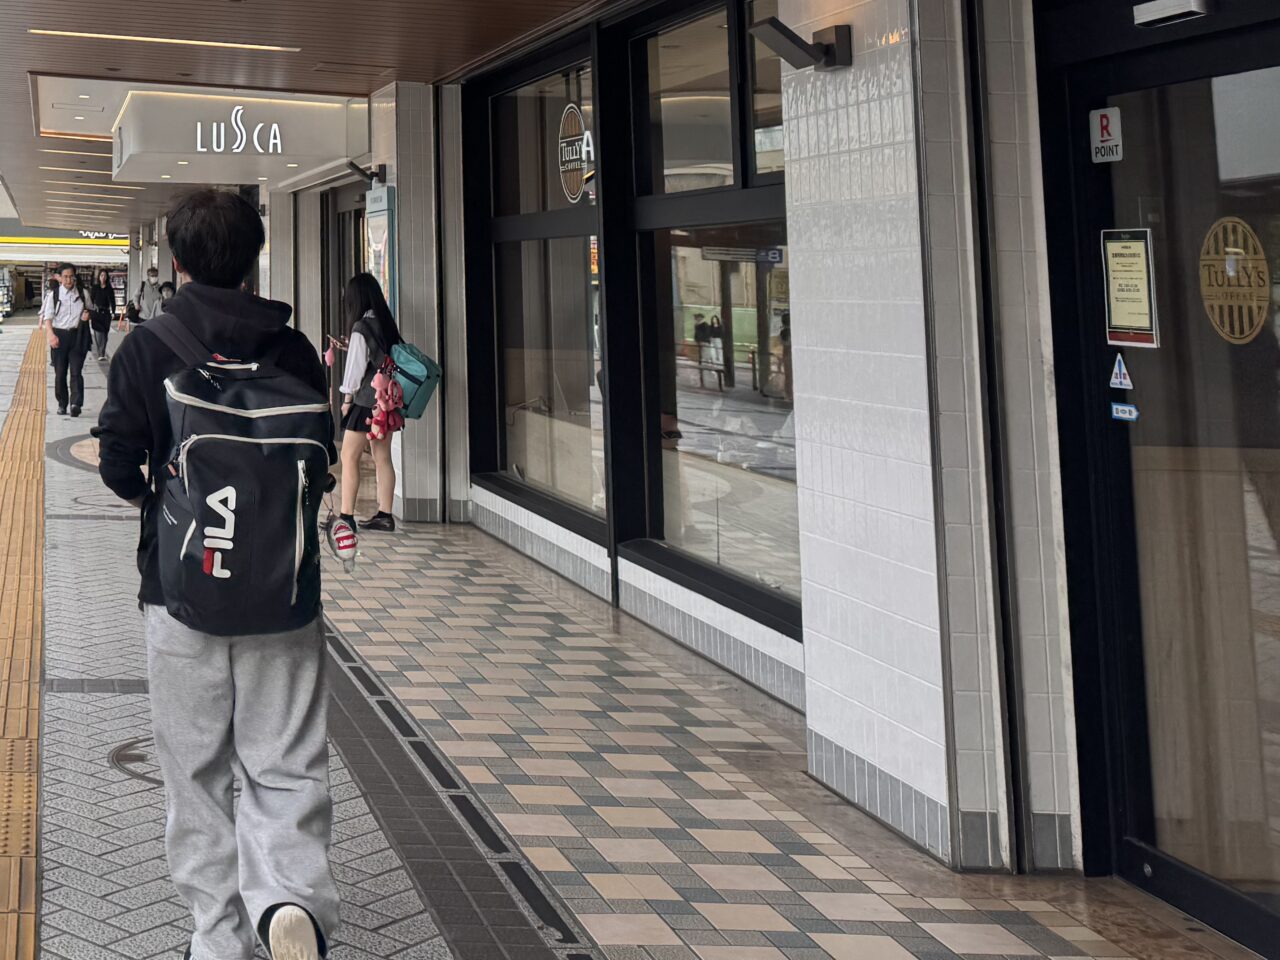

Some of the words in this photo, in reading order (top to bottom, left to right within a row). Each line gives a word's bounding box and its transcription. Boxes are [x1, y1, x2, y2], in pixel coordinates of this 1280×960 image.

[196, 106, 282, 153] LUSCA
[1100, 113, 1113, 138] R
[560, 140, 583, 162] TULLY
[1095, 144, 1120, 158] POINT
[1202, 264, 1266, 287] TULLY'S
[202, 485, 237, 579] FILA
